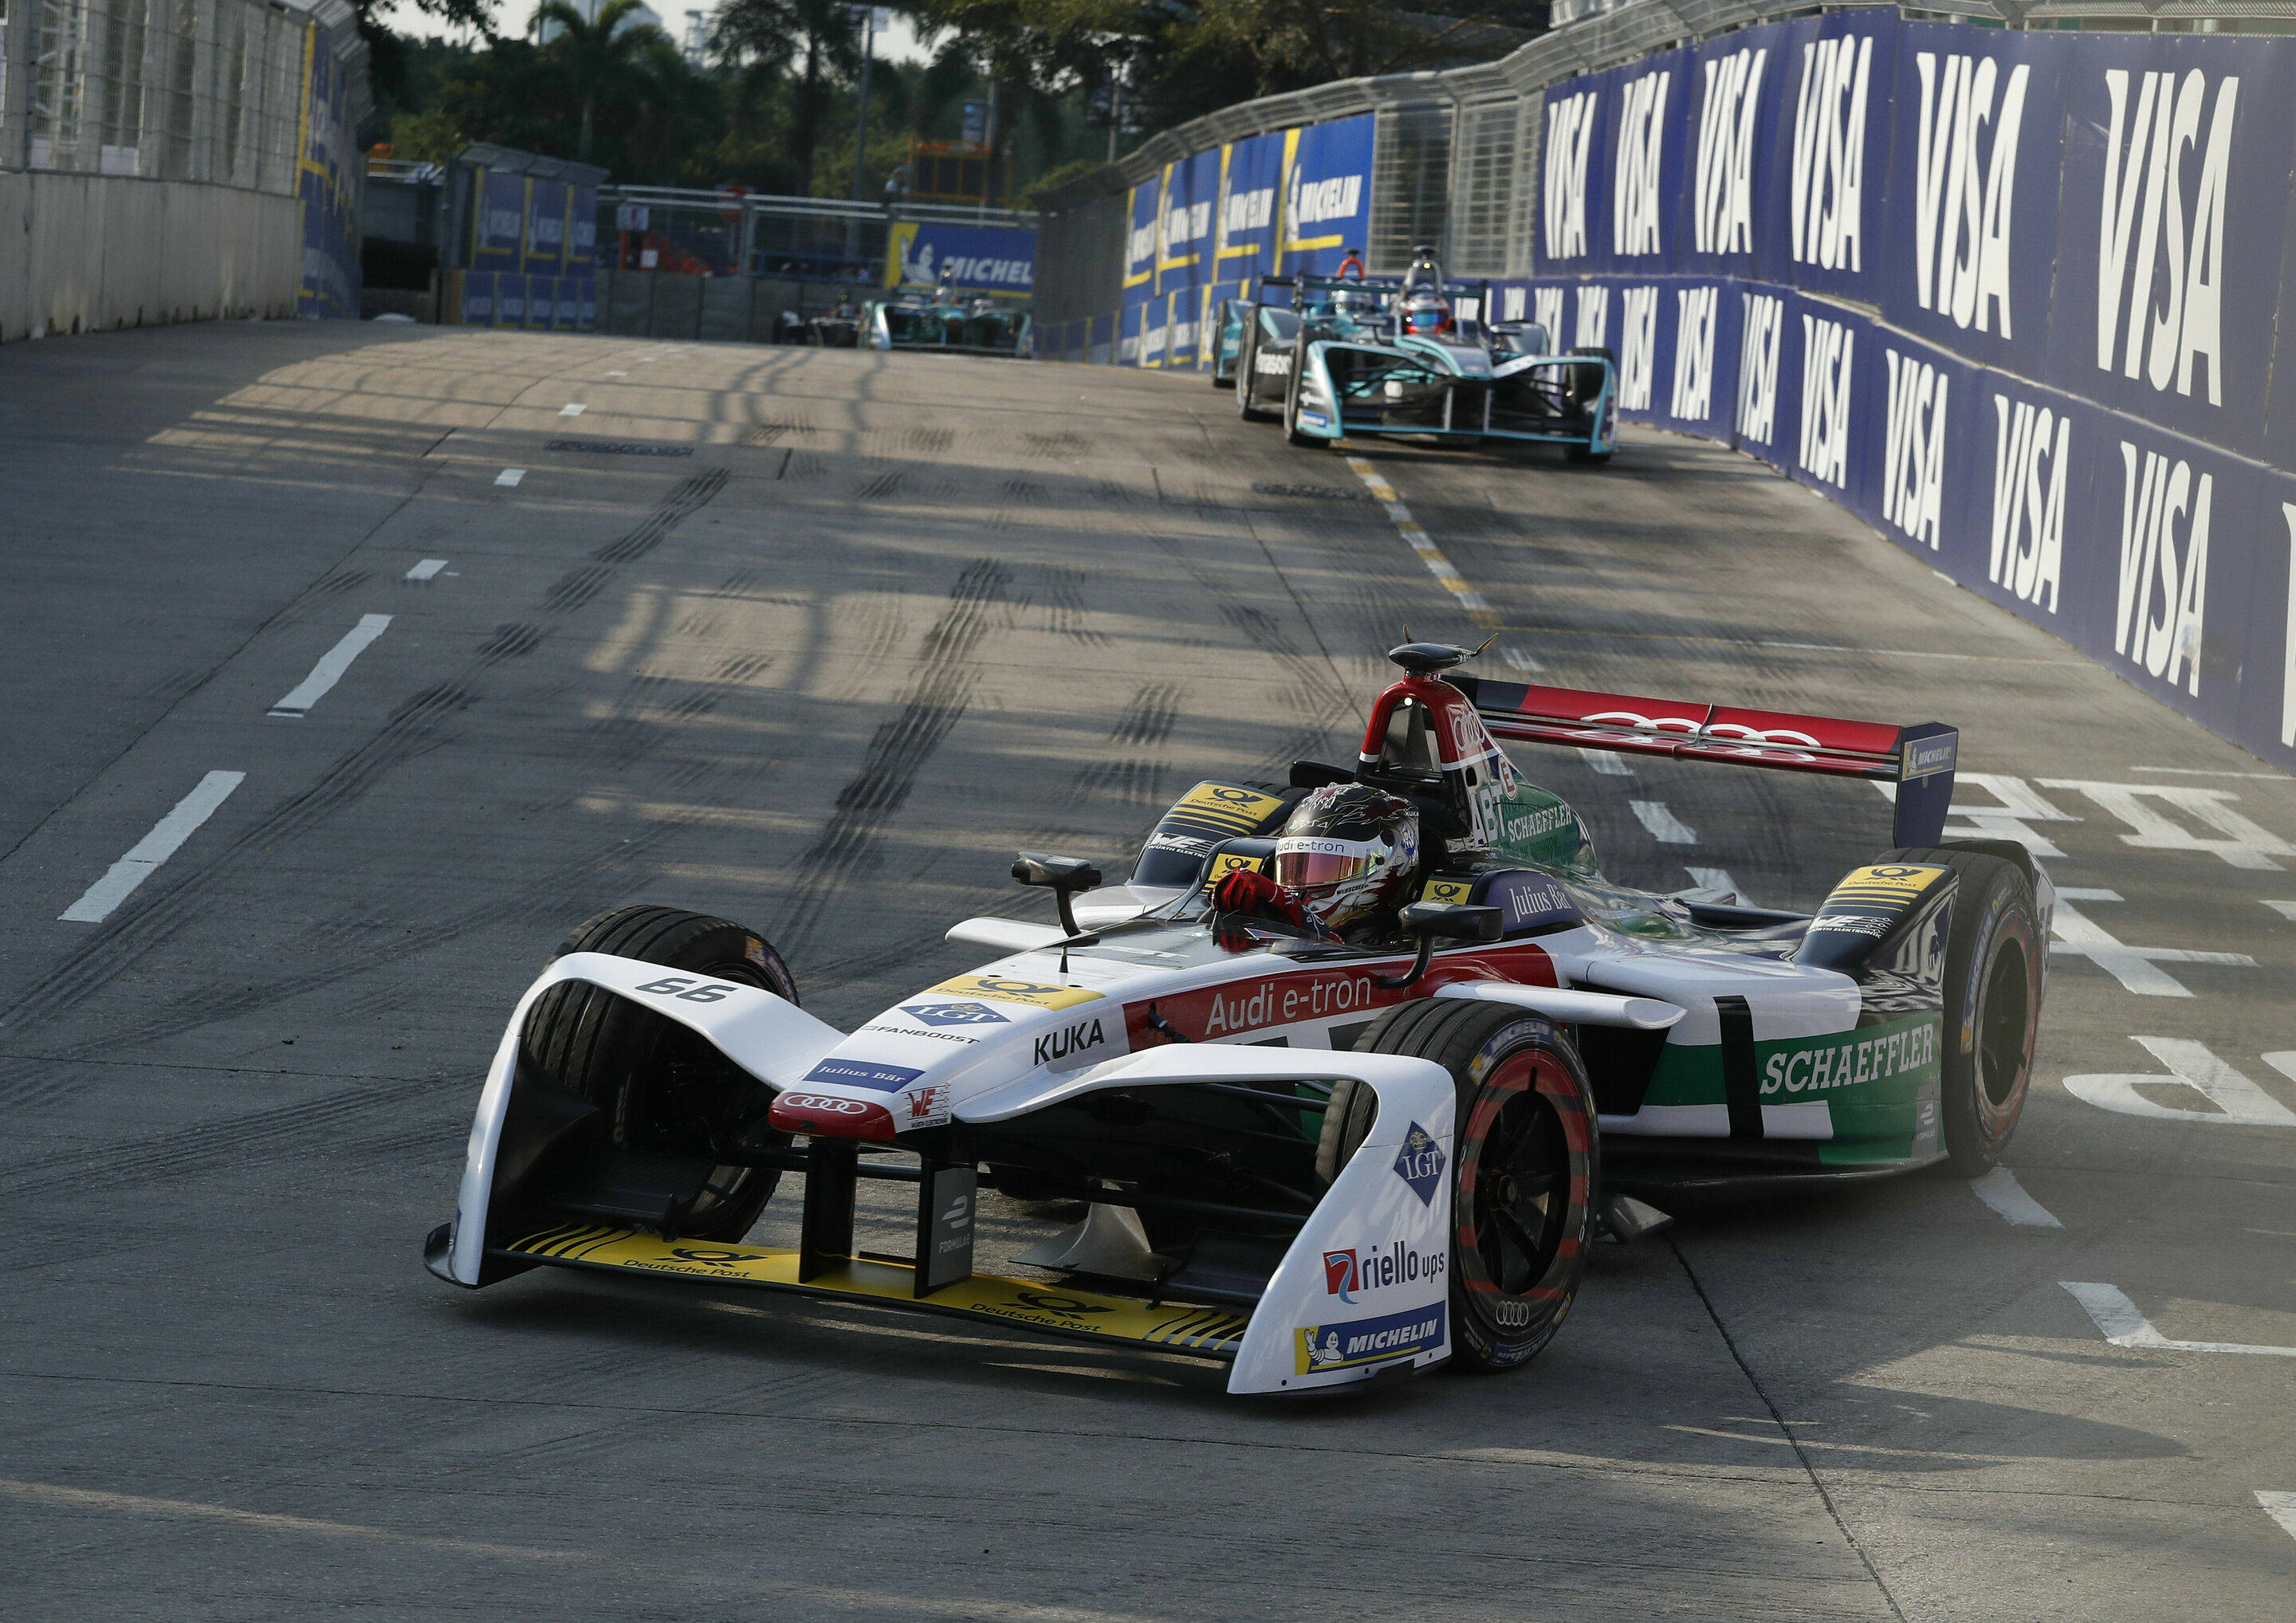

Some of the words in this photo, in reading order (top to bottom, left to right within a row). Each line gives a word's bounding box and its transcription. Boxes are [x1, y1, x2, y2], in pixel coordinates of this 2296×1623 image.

[1545, 92, 1597, 258] VISA
[1614, 72, 1670, 256] VISA
[1695, 49, 1767, 255] VISA
[1792, 34, 1873, 273] VISA
[1917, 52, 2031, 340] VISA
[2097, 68, 2239, 407] VISA
[1619, 285, 1658, 411] VISA
[1670, 285, 1718, 421] VISA
[1736, 292, 1783, 446] VISA
[1800, 313, 1854, 489] VISA
[1883, 348, 1948, 551] VISA
[1989, 393, 2070, 615] VISA
[2115, 441, 2212, 697] VISA
[1190, 798, 1236, 810] Deutsche
[1236, 808, 1258, 816] Post
[1471, 784, 1506, 847] ABT
[1508, 803, 1572, 843] SCHAEFFLER
[1296, 841, 1345, 853] e-tron
[1509, 885, 1553, 923] Julius
[1546, 883, 1572, 910] Bär
[1834, 927, 1883, 939] ELEKTRONIK
[635, 977, 738, 1003] 66
[910, 1006, 999, 1023] LGT
[936, 988, 1012, 1002] Deutsche
[1014, 997, 1051, 1006] Post
[1205, 983, 1274, 1035] Audi
[1282, 975, 1372, 1020] e-tron
[875, 1025, 981, 1045] FANBOOST
[1034, 1018, 1106, 1067] KUKA
[1759, 1023, 1934, 1095] SCHAEFFLER
[817, 1065, 869, 1078] Julius
[871, 1072, 907, 1083] Bär
[908, 1088, 937, 1118] WE
[1402, 1150, 1443, 1181] LGT
[623, 1259, 707, 1275] Deutsche
[710, 1267, 752, 1279] Post
[1362, 1240, 1418, 1291] riello
[1422, 1250, 1445, 1287] ups
[970, 1303, 1055, 1326] Deutsche
[1060, 1319, 1102, 1334] Post
[1346, 1318, 1437, 1354] MICHELIN
